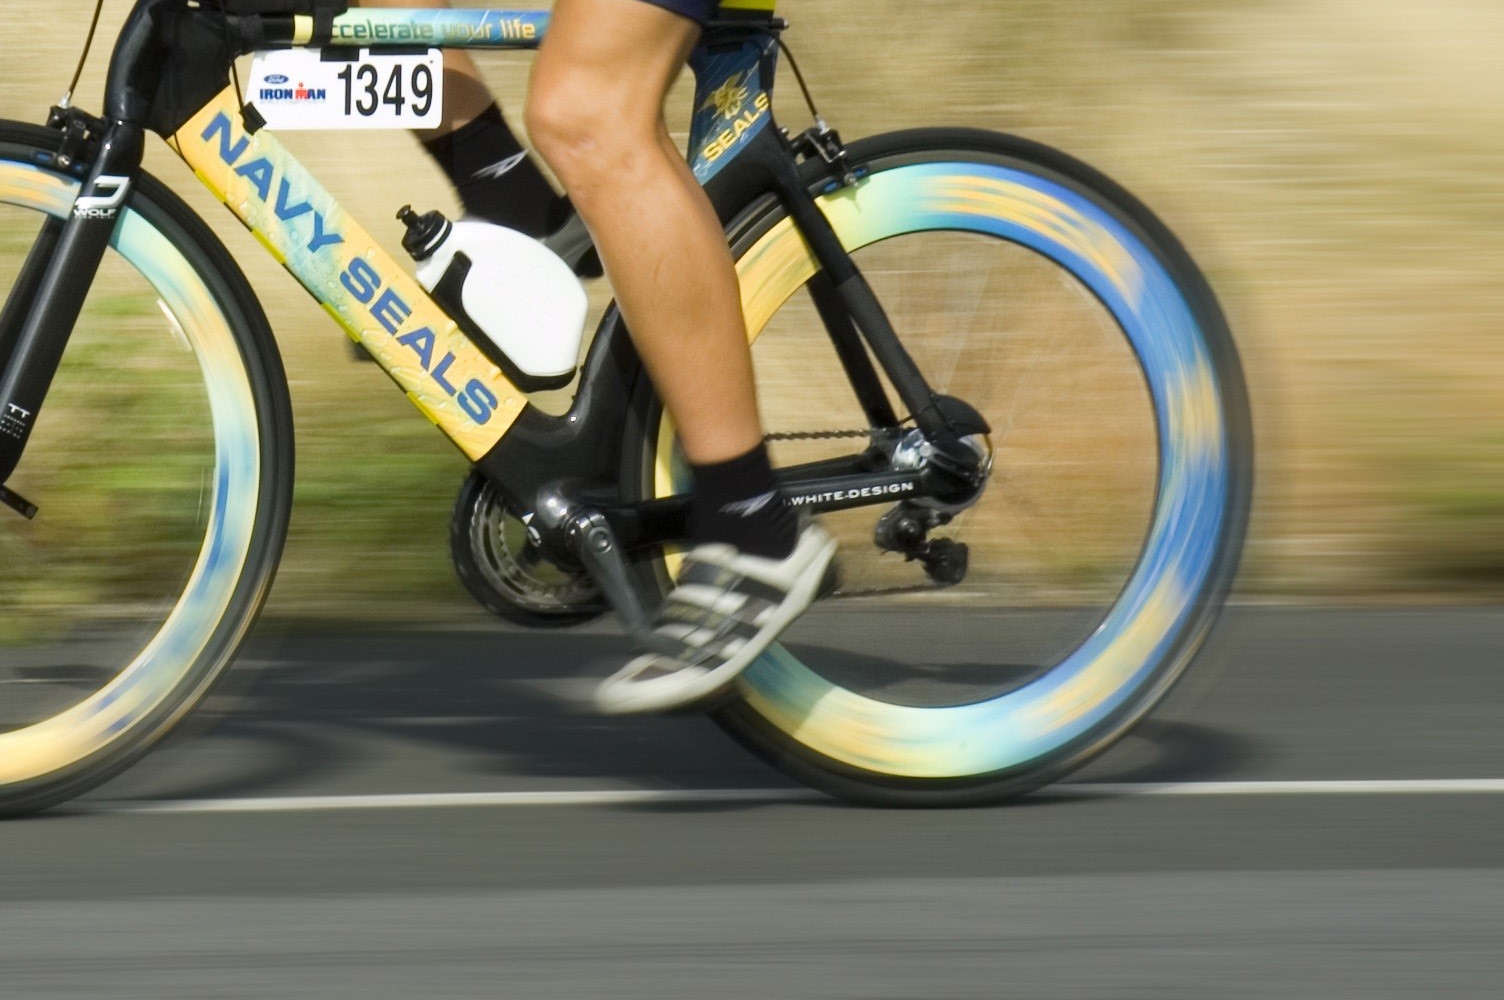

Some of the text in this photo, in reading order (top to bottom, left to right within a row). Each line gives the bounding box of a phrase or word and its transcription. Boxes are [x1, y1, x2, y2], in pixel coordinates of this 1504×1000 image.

[332, 17, 536, 41] ccelerate your life
[337, 63, 434, 117] 1349
[703, 92, 769, 163] SEALS
[73, 208, 116, 218] WOLF
[201, 111, 345, 254] NAVY
[339, 256, 499, 426] SEALS
[8, 402, 31, 419] TT
